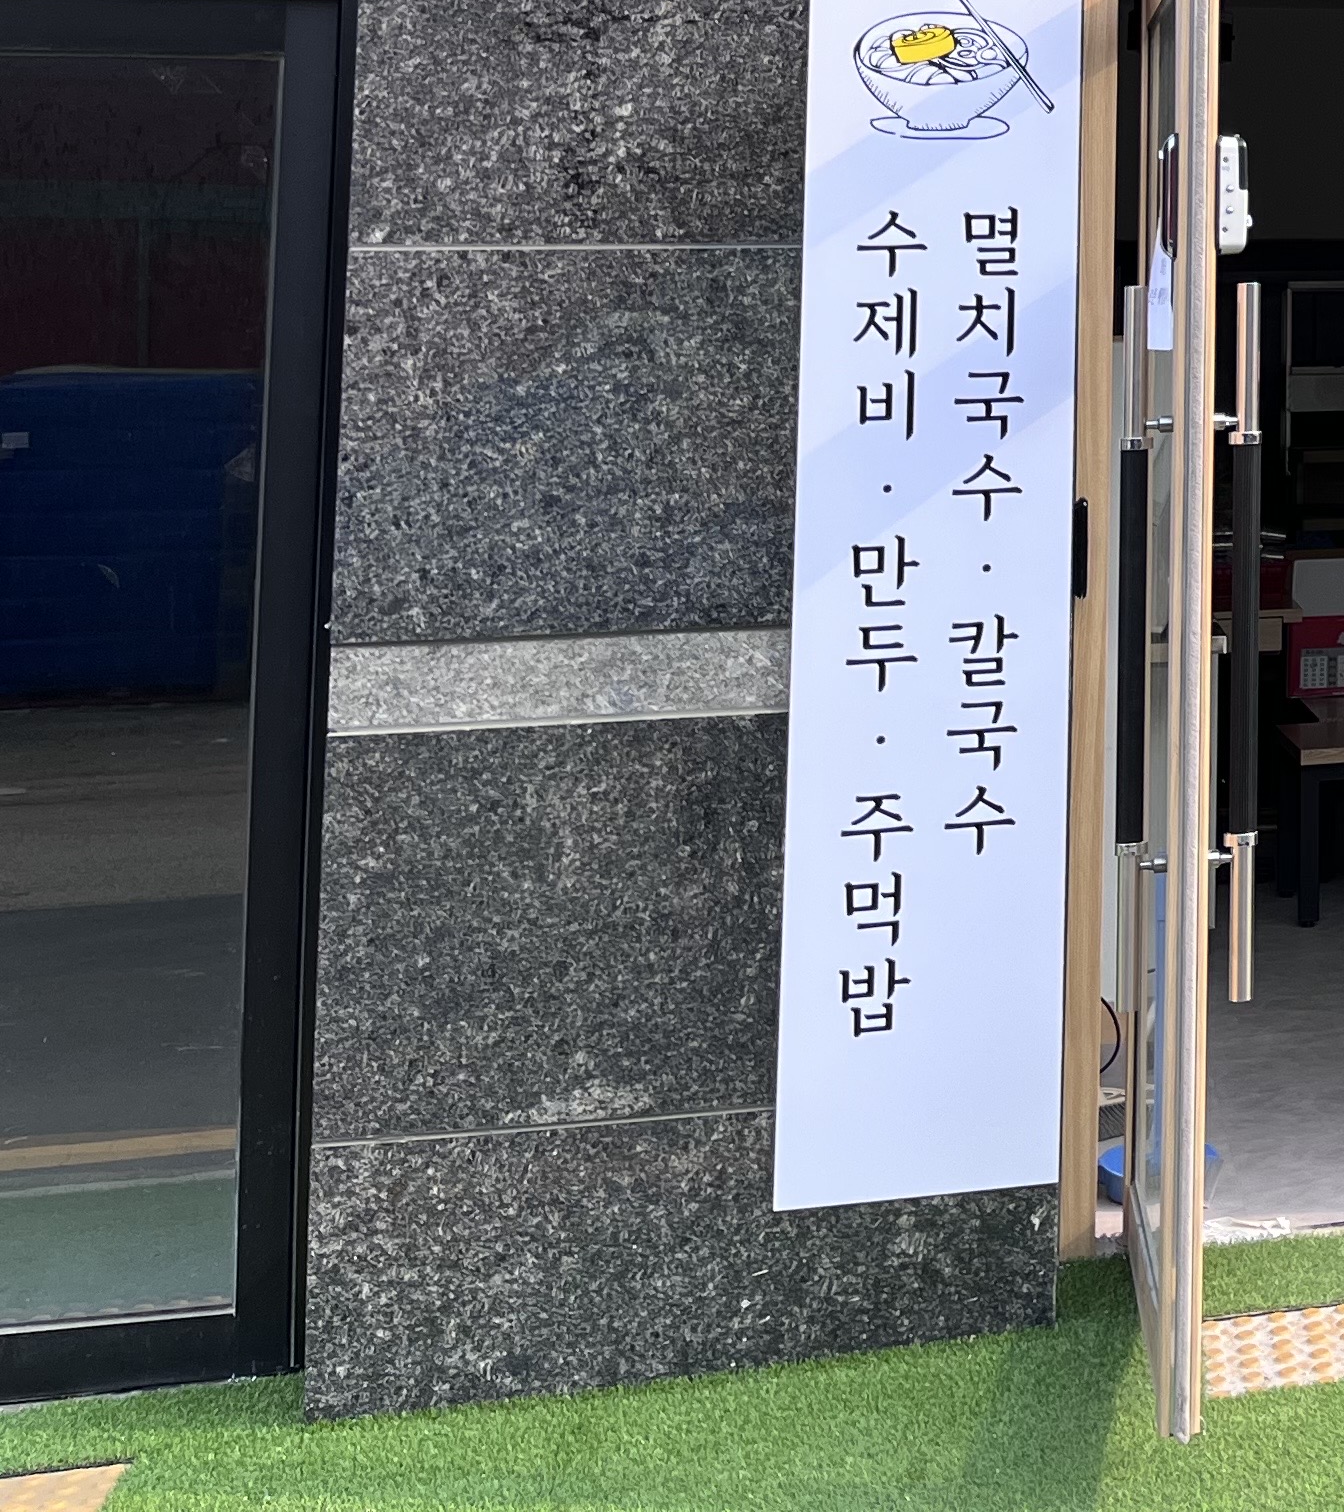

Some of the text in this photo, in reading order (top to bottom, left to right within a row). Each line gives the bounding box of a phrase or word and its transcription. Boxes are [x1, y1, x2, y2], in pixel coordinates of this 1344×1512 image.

[839, 210, 928, 1038] 수제비 만두 주먹밥
[944, 206, 1023, 856] 멸치국수 칼국수
